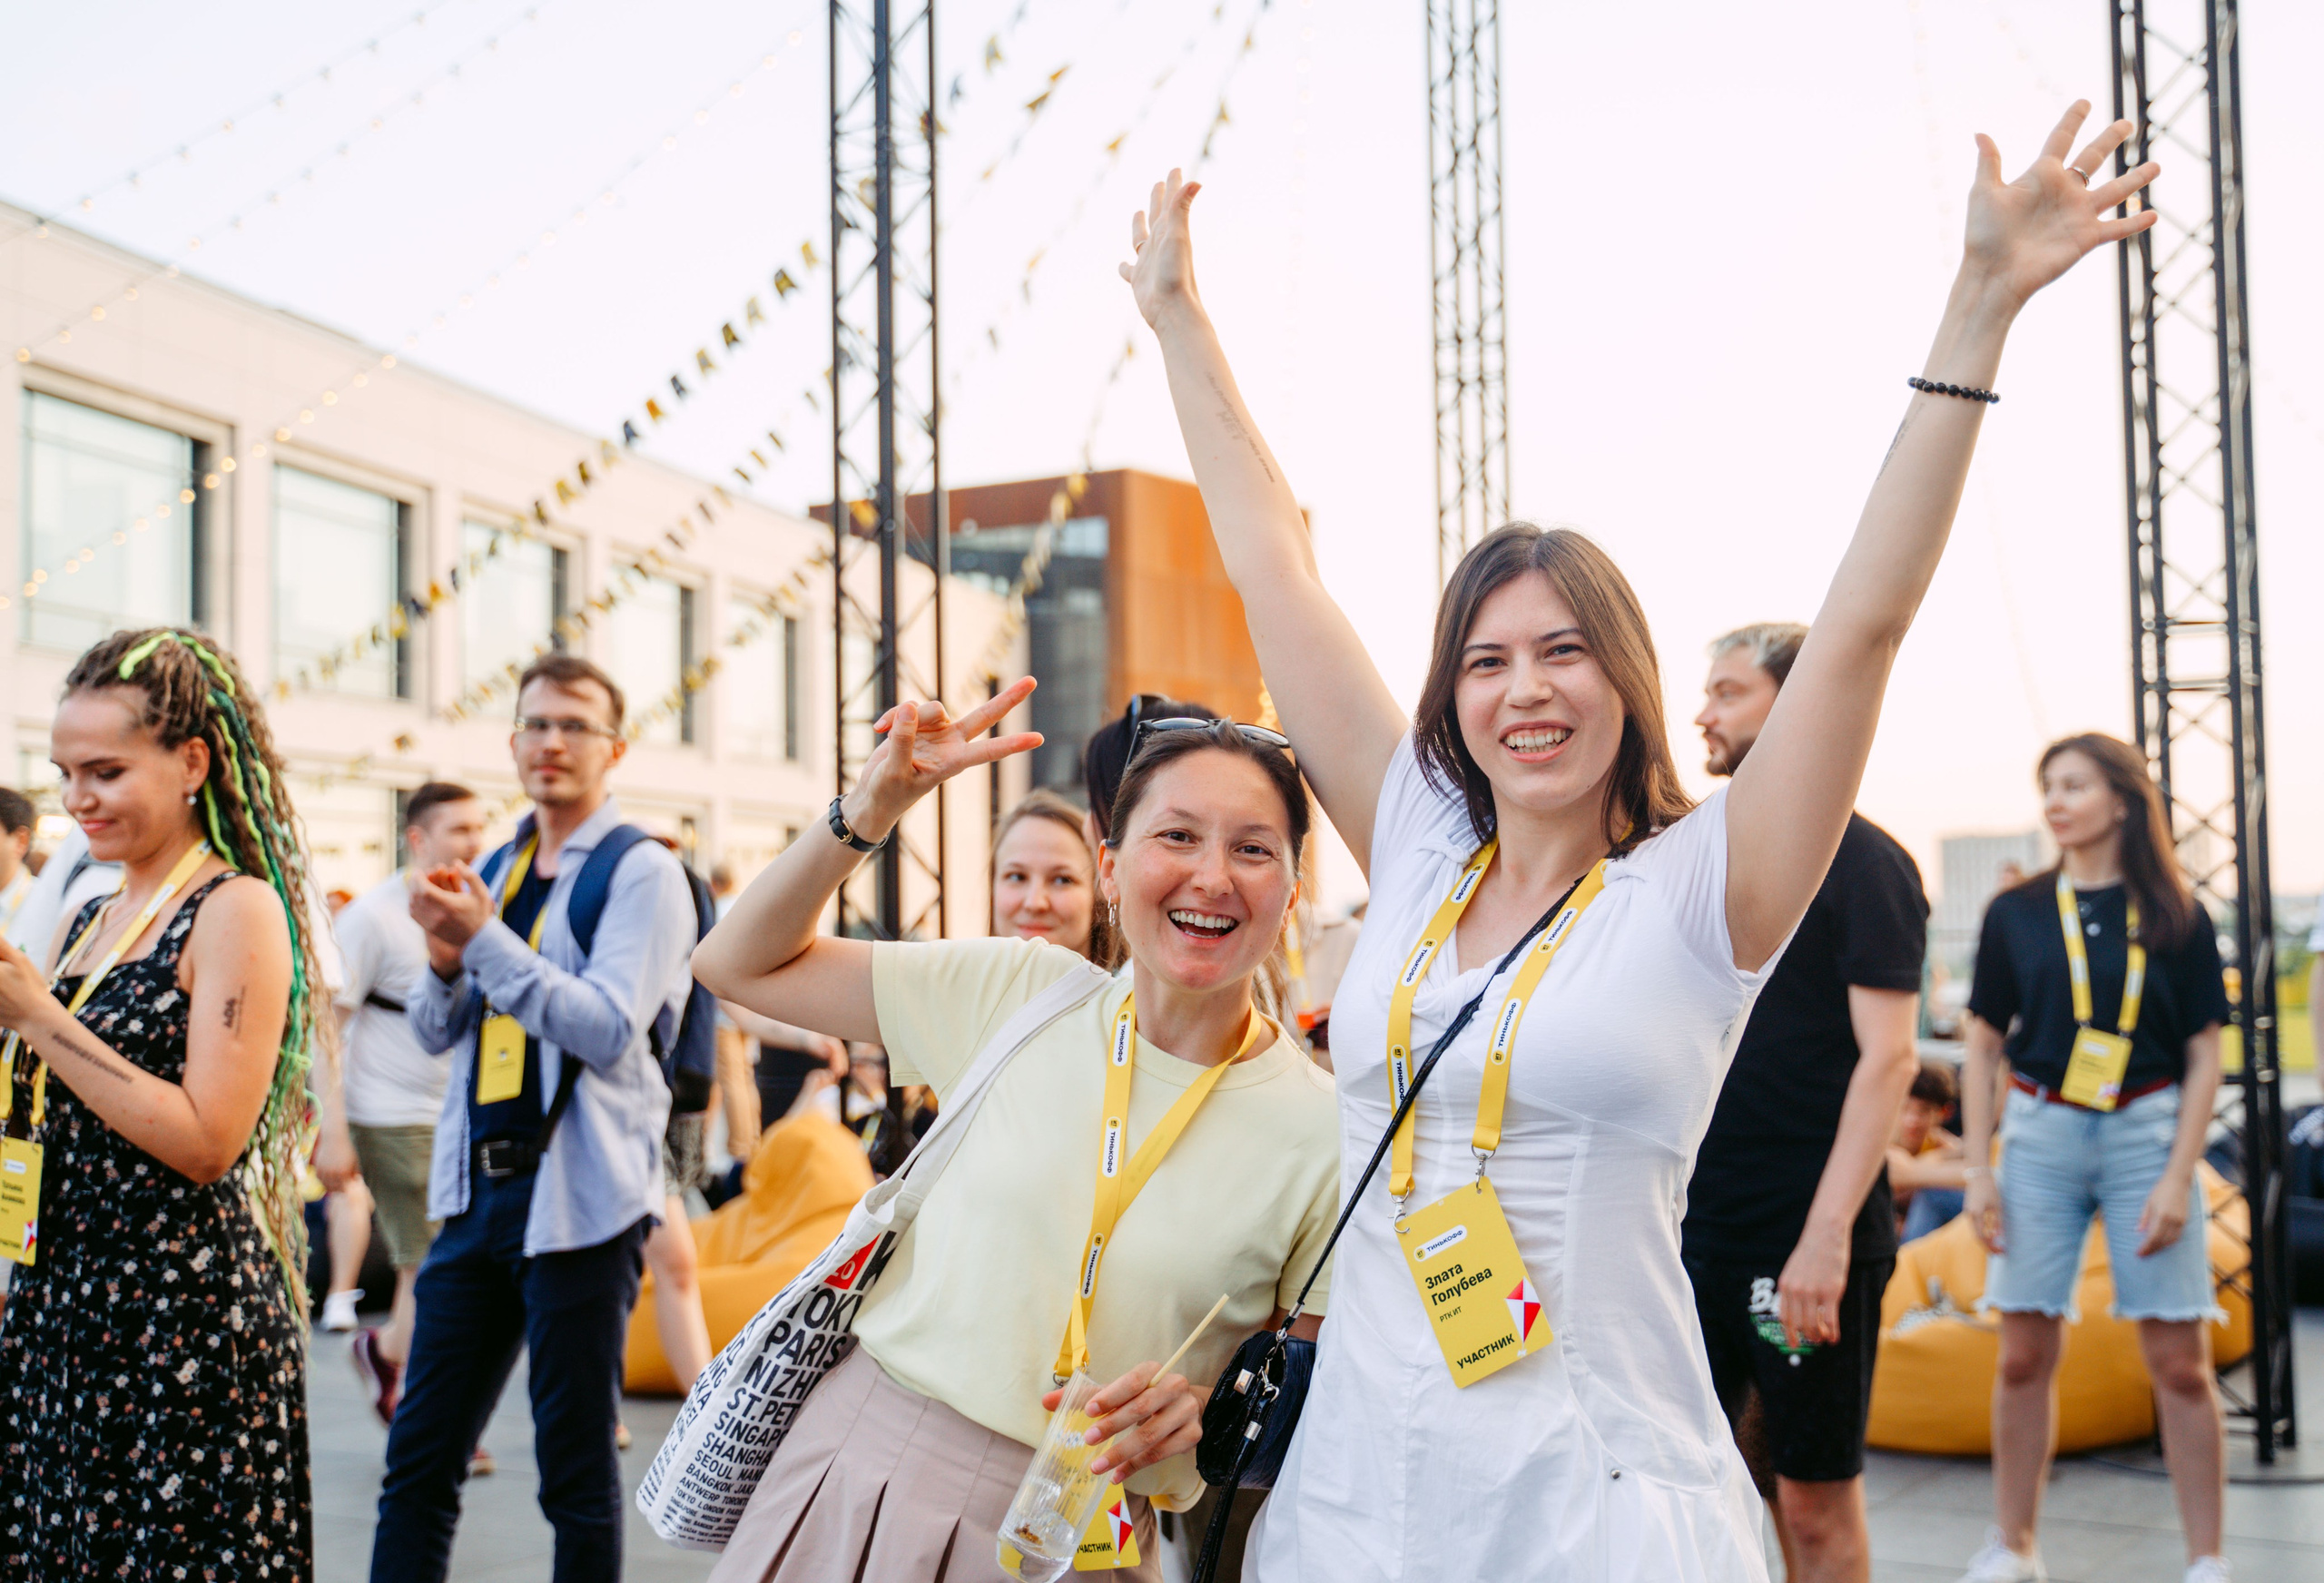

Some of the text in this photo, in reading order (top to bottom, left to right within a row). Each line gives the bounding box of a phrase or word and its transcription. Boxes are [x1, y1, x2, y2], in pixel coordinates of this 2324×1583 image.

[1406, 949, 1428, 982] ТИНЬКОФФ
[1498, 1002, 1516, 1047] ТИНЬКОФФ
[1118, 1024, 1126, 1062] ТИНЬКОФФ
[1107, 1131, 1116, 1173] ТИНЬКОФФ
[1426, 1230, 1463, 1252] ТИНЬКОФФ
[1425, 1263, 1463, 1290] Злата
[1431, 1268, 1492, 1306] Голубева
[1439, 1306, 1462, 1322] РТК ИТ
[763, 1321, 847, 1370] PARIS
[1456, 1333, 1515, 1369] УЧАСТНИК
[685, 1463, 734, 1493] BANGKOK
[694, 1450, 733, 1480] SEOUL
[675, 1487, 696, 1504] TOKYO
[698, 1501, 724, 1514] LONDON
[679, 1477, 721, 1502] ANTWERP
[670, 1496, 698, 1517] SINGAPORE
